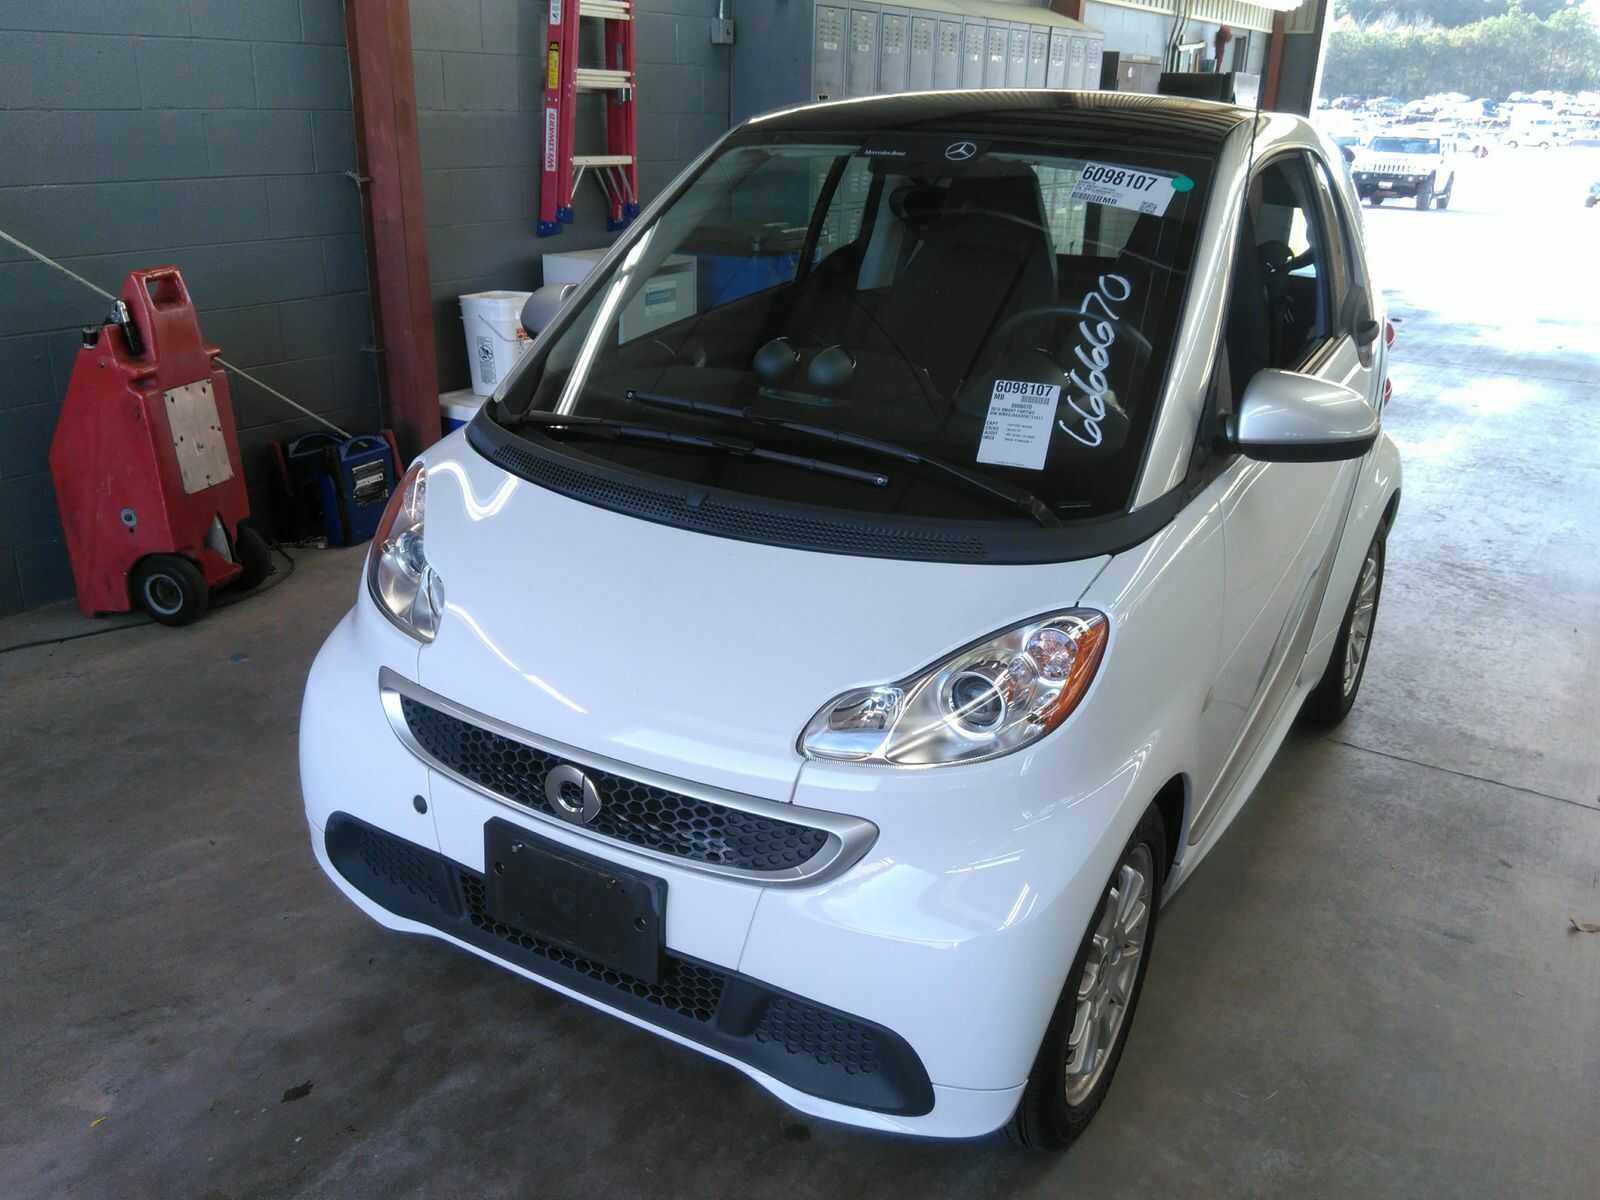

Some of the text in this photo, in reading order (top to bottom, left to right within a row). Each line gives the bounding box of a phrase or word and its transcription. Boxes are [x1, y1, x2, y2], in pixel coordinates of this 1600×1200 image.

[1082, 166, 1158, 192] 6098107
[1058, 274, 1131, 447] 6666670
[995, 381, 1053, 397] 6098107
